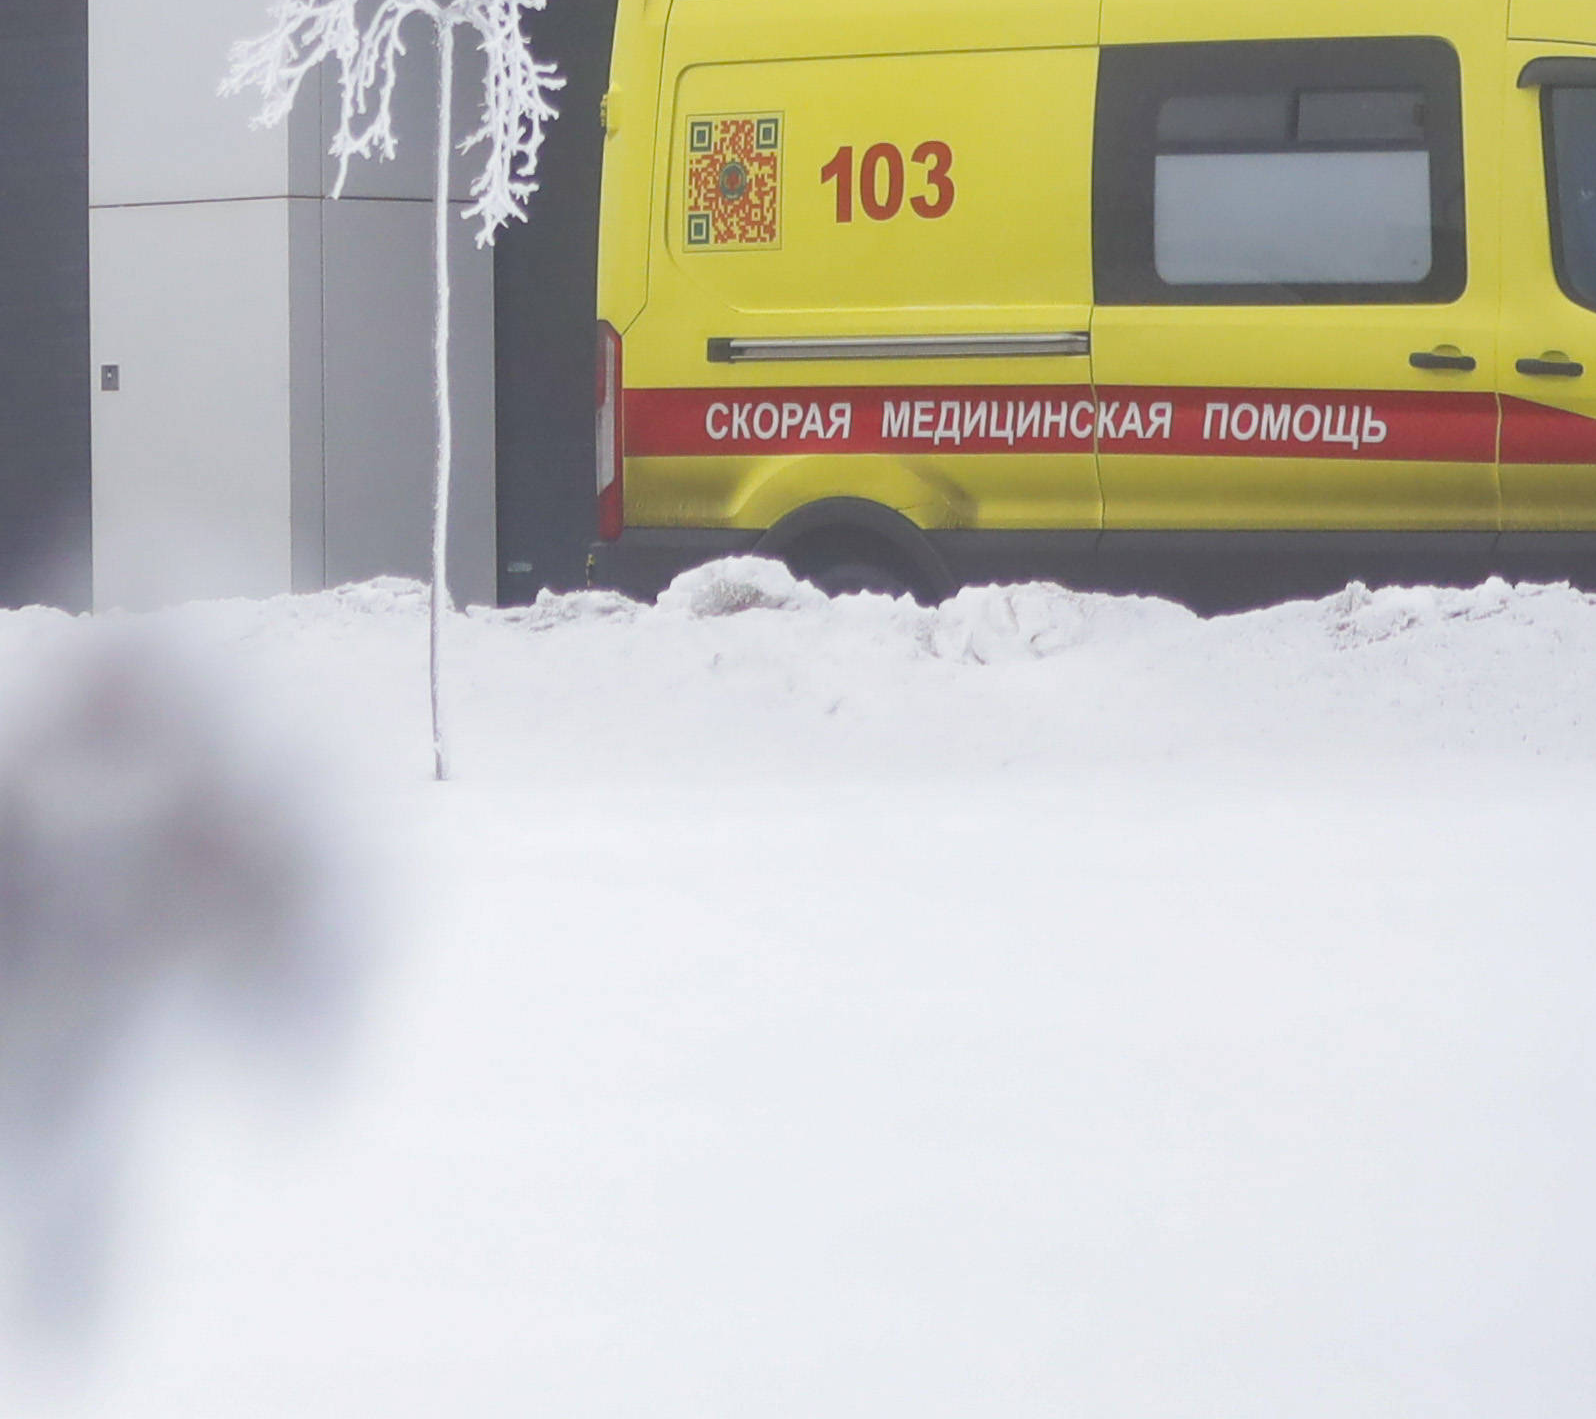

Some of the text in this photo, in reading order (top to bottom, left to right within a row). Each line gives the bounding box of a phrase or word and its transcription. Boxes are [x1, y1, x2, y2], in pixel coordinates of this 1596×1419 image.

[820, 139, 956, 224] 103
[704, 400, 1388, 451] СКОРАЯ МЕДИЦИНСКАЯ ПОМОЩЬ
